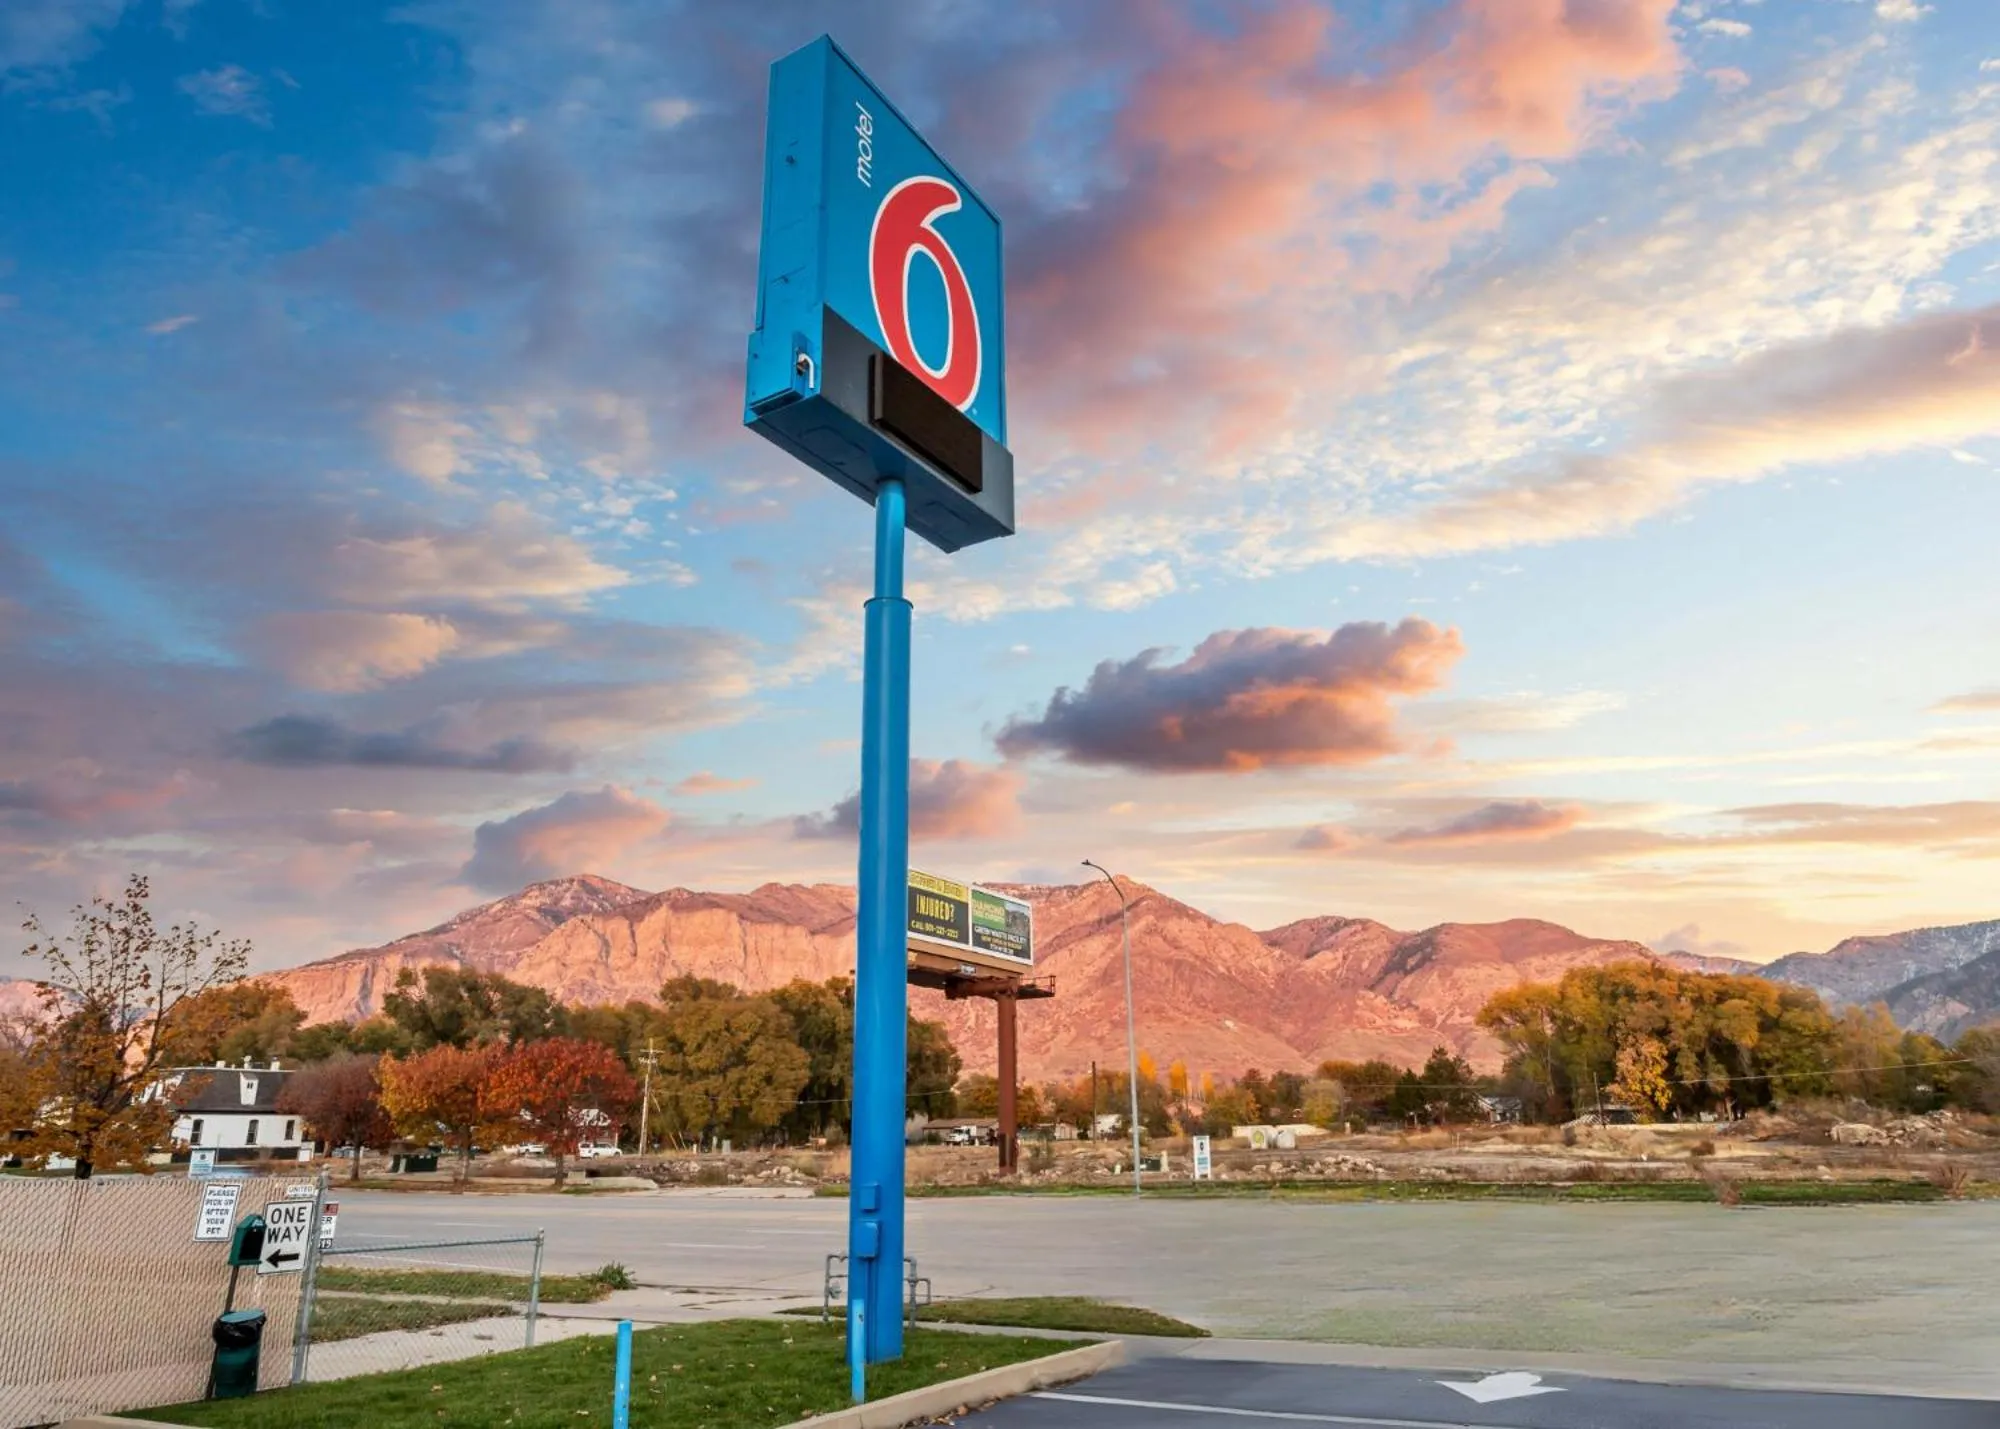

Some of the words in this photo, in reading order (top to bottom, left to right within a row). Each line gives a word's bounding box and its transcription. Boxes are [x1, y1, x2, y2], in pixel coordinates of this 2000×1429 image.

[856, 101, 873, 189] motel
[868, 175, 982, 413] 6
[915, 894, 955, 923] INJURED?
[208, 1189, 236, 1197] PLEASE
[205, 1208, 230, 1216] AFTER
[271, 1206, 307, 1225] ONE
[206, 1227, 222, 1235] PET
[267, 1225, 305, 1244] WAY
